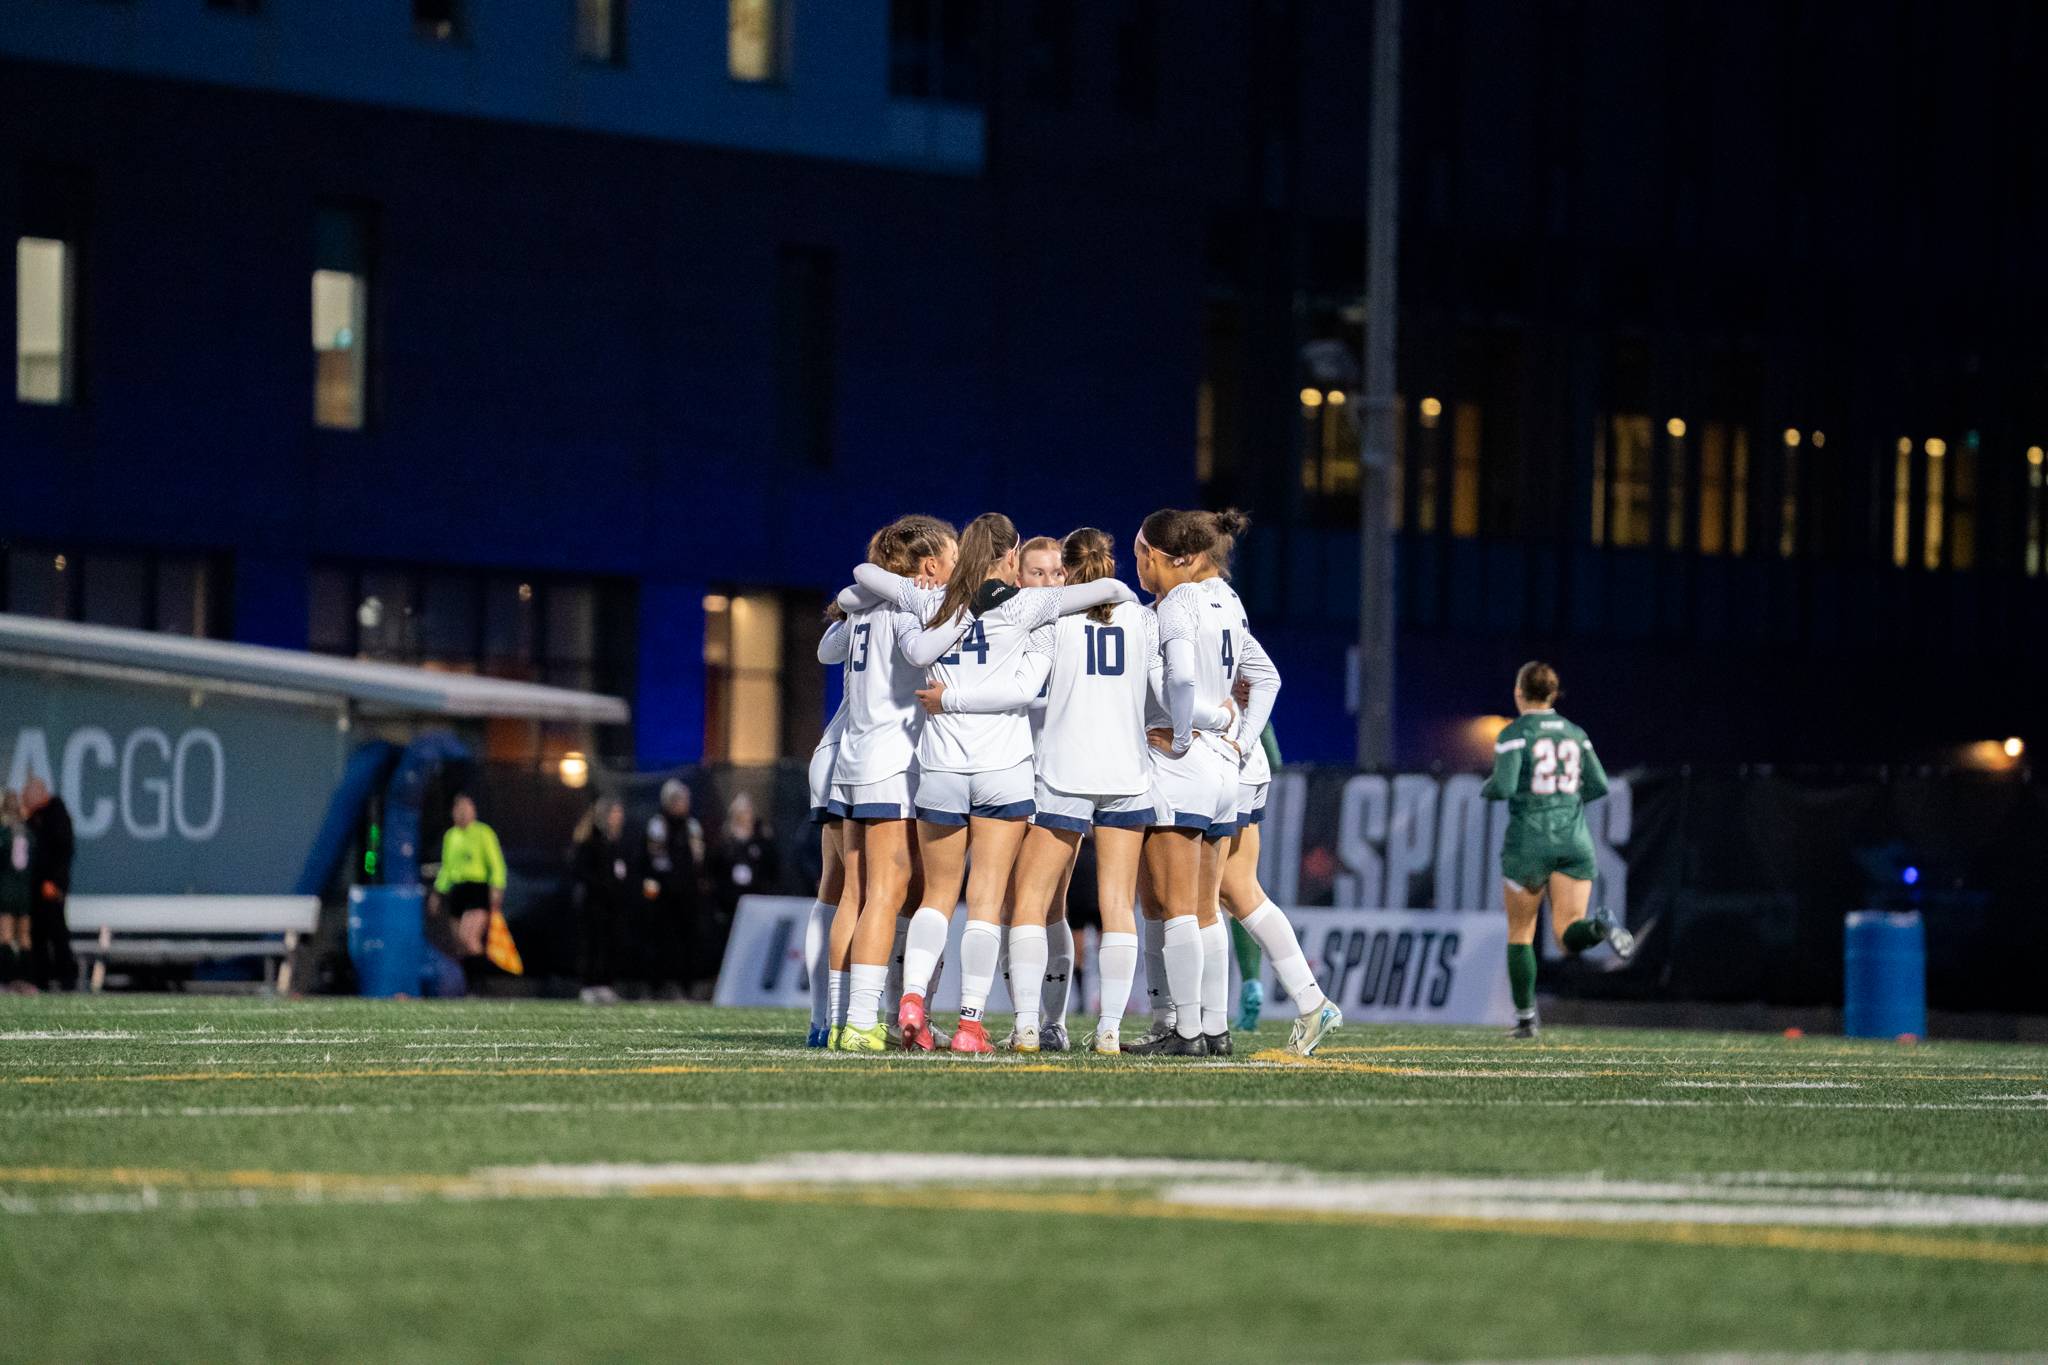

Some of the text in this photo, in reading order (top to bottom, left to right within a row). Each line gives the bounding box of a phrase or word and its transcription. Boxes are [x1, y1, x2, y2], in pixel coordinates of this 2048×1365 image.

[1084, 625, 1125, 676] 10
[1221, 629, 1235, 679] 4
[1532, 738, 1580, 794] 23
[1318, 929, 1459, 1008] SPORTS
